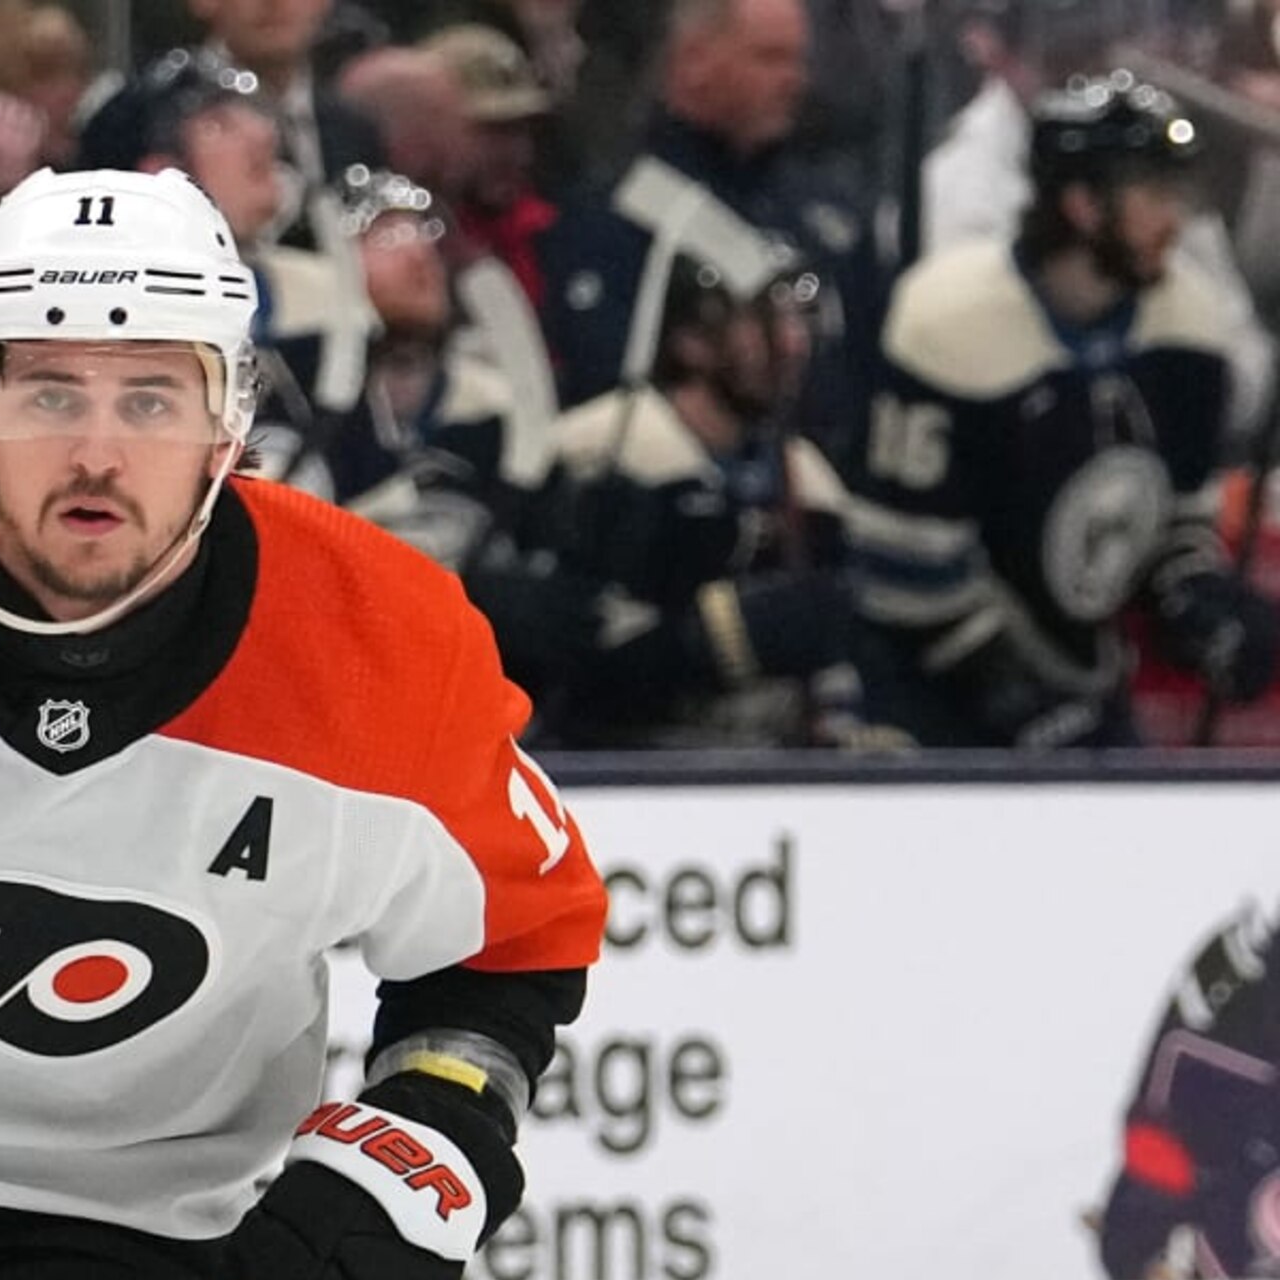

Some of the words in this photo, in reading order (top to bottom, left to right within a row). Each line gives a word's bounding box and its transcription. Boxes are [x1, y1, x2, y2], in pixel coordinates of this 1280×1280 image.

[73, 196, 115, 226] 11
[39, 269, 138, 285] BAUER
[207, 796, 275, 882] A
